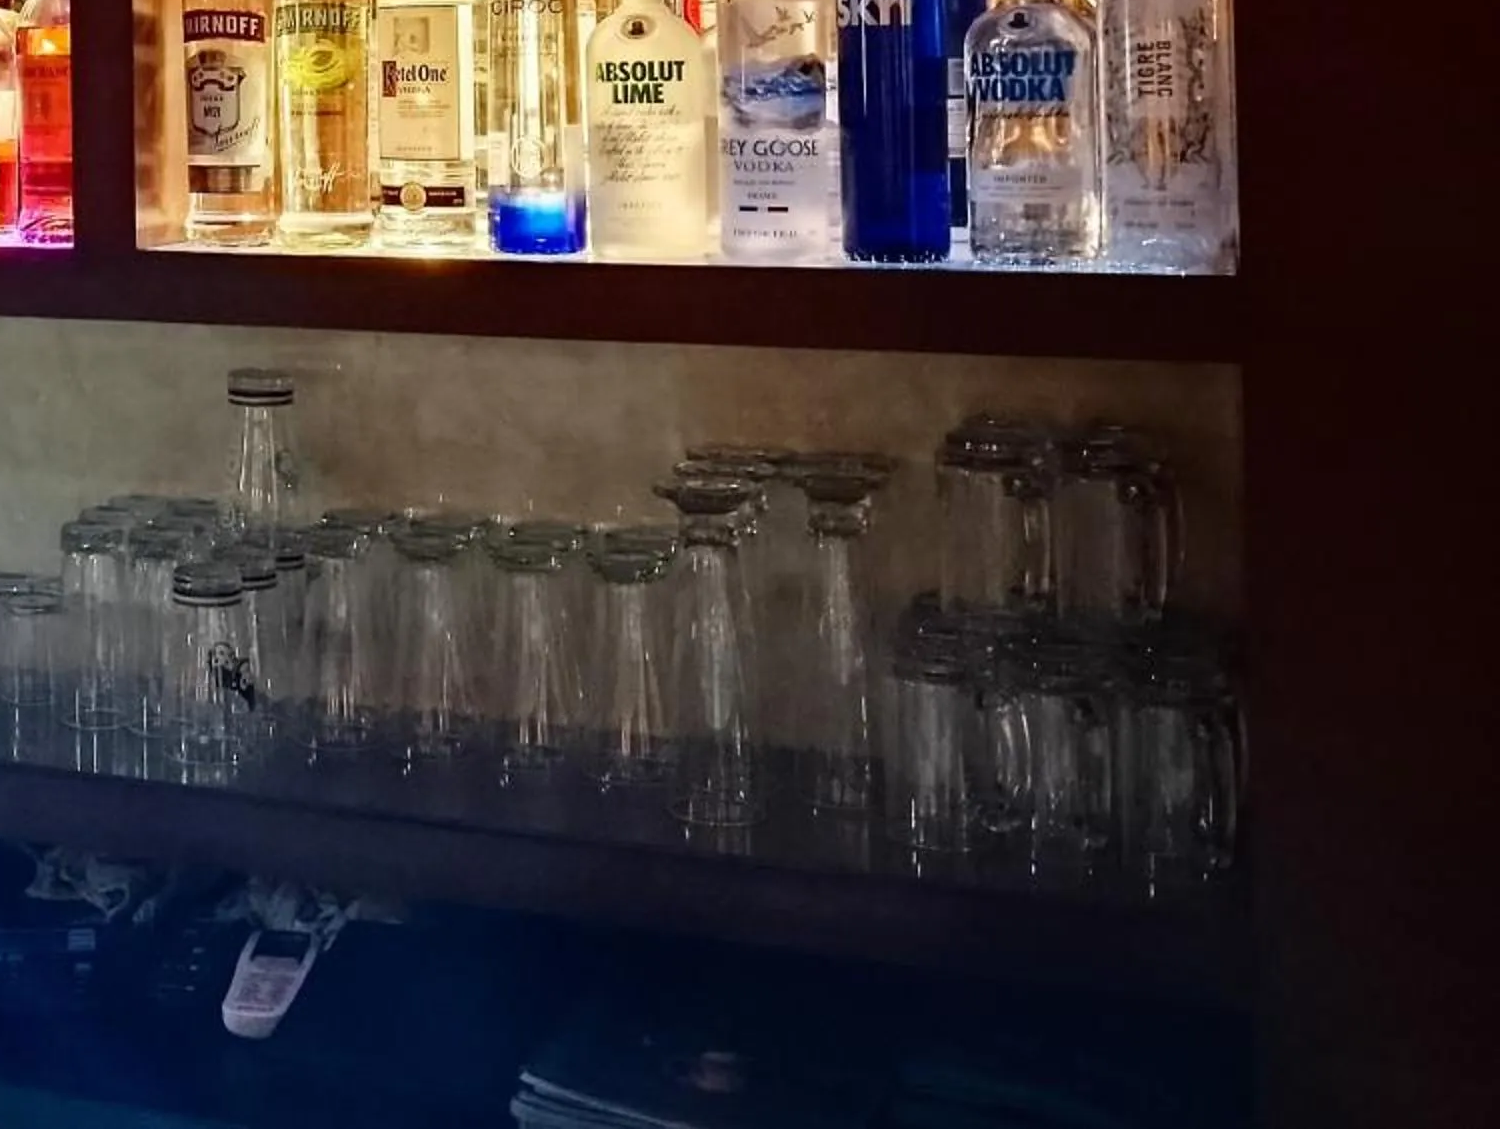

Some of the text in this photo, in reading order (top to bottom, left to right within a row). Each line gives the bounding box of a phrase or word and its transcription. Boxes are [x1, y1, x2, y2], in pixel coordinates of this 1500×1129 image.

[418, 64, 448, 83] One
[595, 60, 685, 82] ABSOLUT
[969, 49, 1078, 77] ABSOLUT
[1137, 41, 1155, 99] TIGRE
[1156, 40, 1173, 99] BLANC
[612, 83, 665, 104] LIME
[977, 76, 1066, 102] VODKA
[753, 136, 820, 157] GOOSE
[733, 159, 796, 173] VODKA
